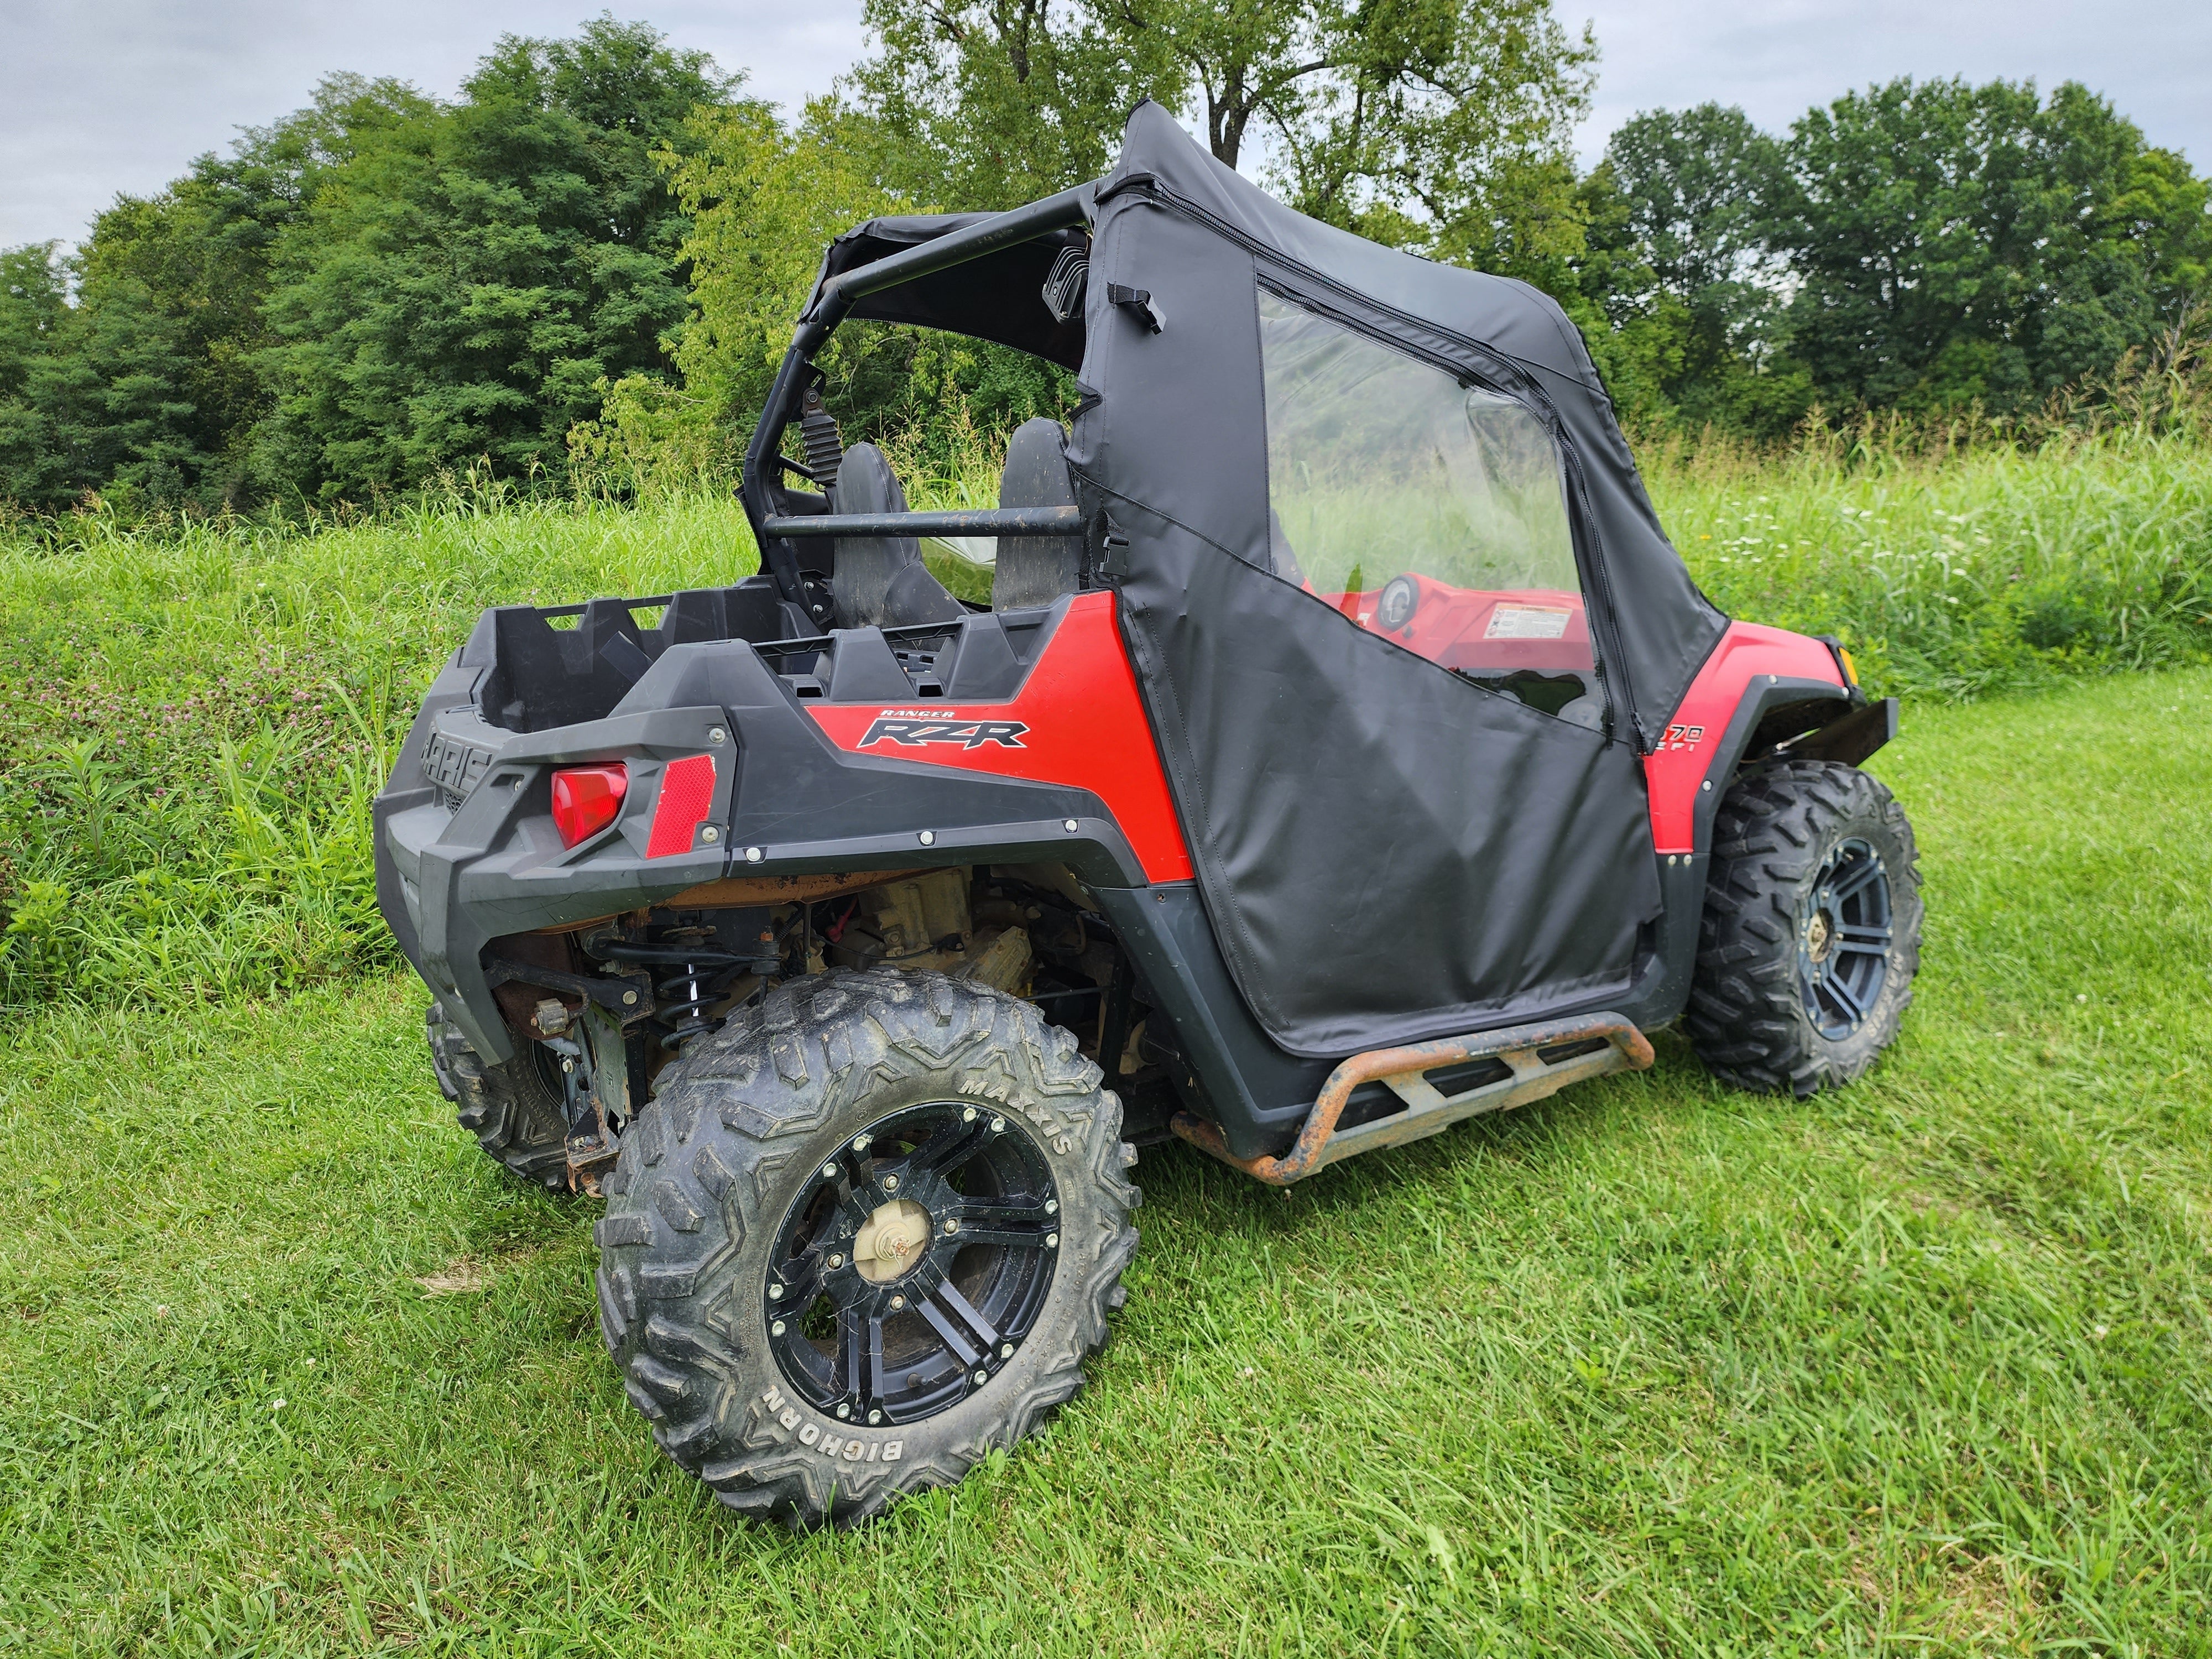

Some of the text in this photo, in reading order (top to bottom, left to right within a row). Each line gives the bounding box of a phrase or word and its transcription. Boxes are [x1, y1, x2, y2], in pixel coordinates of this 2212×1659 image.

[880, 709, 955, 718] RANGER
[856, 718, 1030, 750] RZR
[1655, 741, 1695, 753] EFI
[1660, 724, 1706, 743] 70
[1866, 951, 1904, 1039] MAXXIS
[957, 1079, 1073, 1155] MAXXIS
[762, 1385, 904, 1462] BIGHORN
